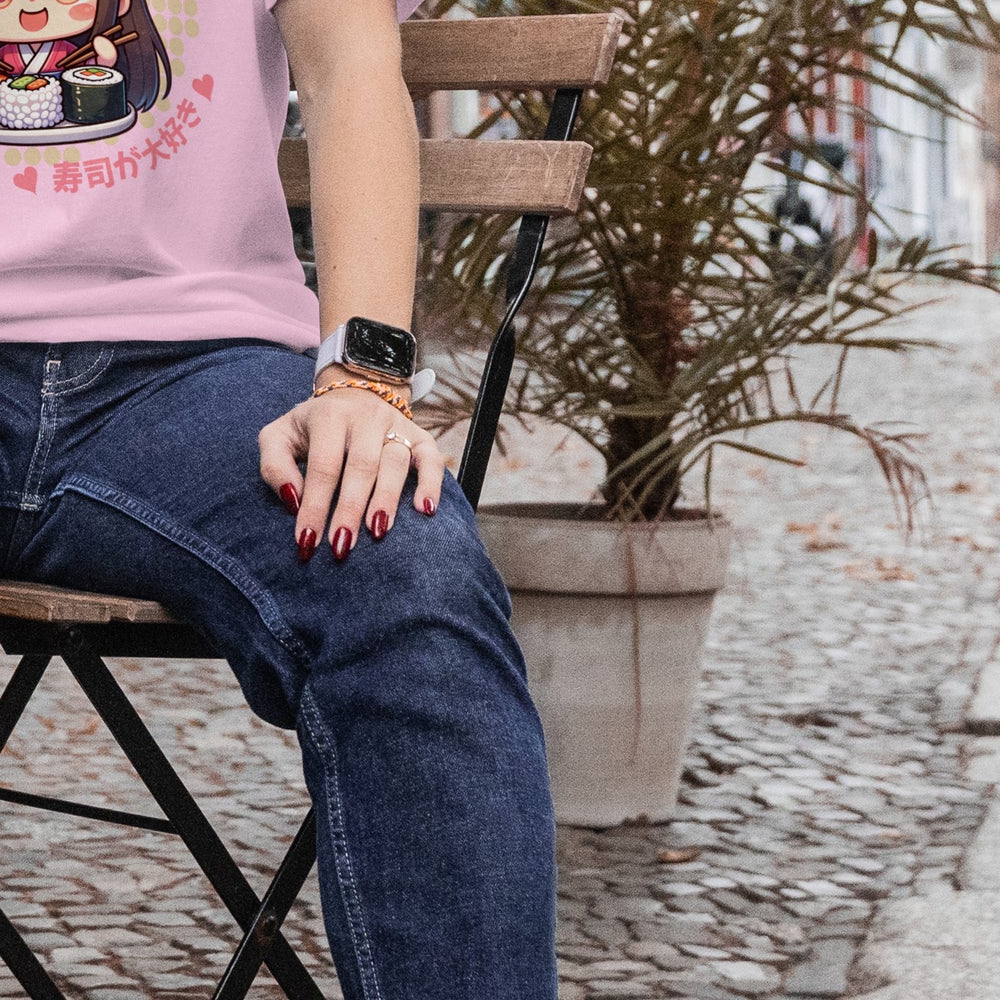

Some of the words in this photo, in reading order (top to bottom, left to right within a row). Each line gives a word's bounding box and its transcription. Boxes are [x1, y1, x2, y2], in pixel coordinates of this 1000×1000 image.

[52, 98, 201, 193] 寿司が大好き
